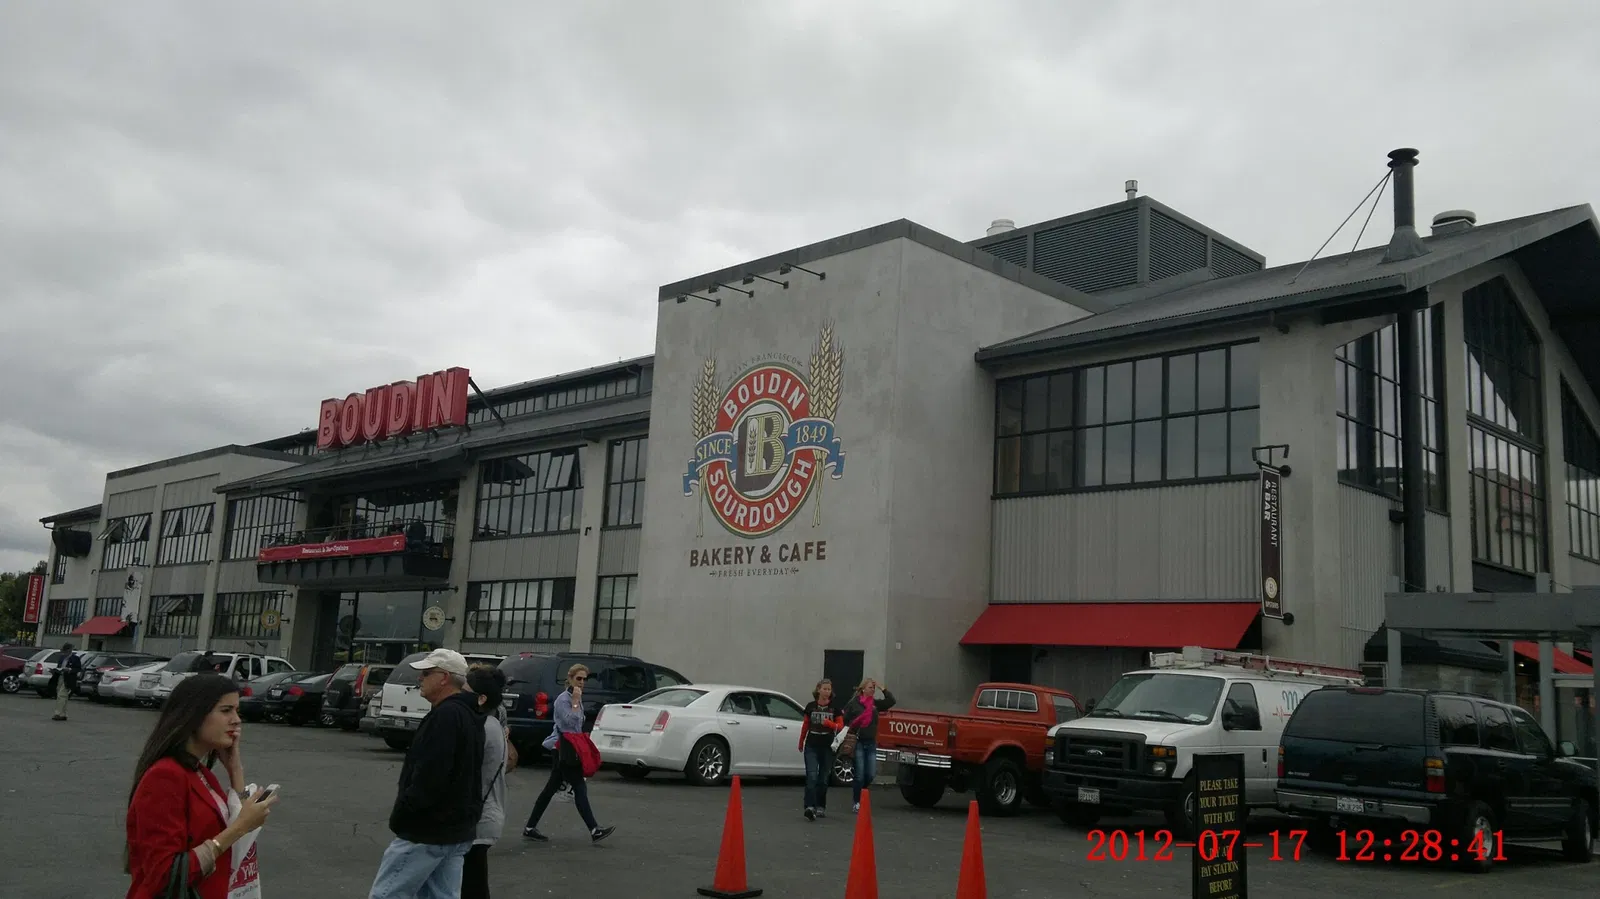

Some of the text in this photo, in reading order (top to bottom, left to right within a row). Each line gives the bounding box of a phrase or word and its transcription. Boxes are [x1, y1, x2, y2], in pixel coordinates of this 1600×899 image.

[751, 352, 797, 364] FRANCISCO
[723, 372, 805, 420] BOUDIN
[316, 366, 469, 450] BOUDIN
[696, 425, 827, 460] SINCE 1849
[744, 411, 785, 477] B
[1265, 479, 1271, 489] &
[710, 458, 812, 528] SOURDOUGH
[690, 540, 827, 567] BAKERY & CAFE
[718, 567, 789, 577] FRESH EVERYDAY
[889, 721, 934, 736] TOYOTA
[1200, 778, 1238, 791] PLEASE TAKE
[1200, 794, 1239, 808] YOUR TICKET
[1203, 811, 1235, 825] WITH YOU
[1201, 861, 1239, 877] PAY STATION
[1209, 879, 1233, 894] BEFORE
